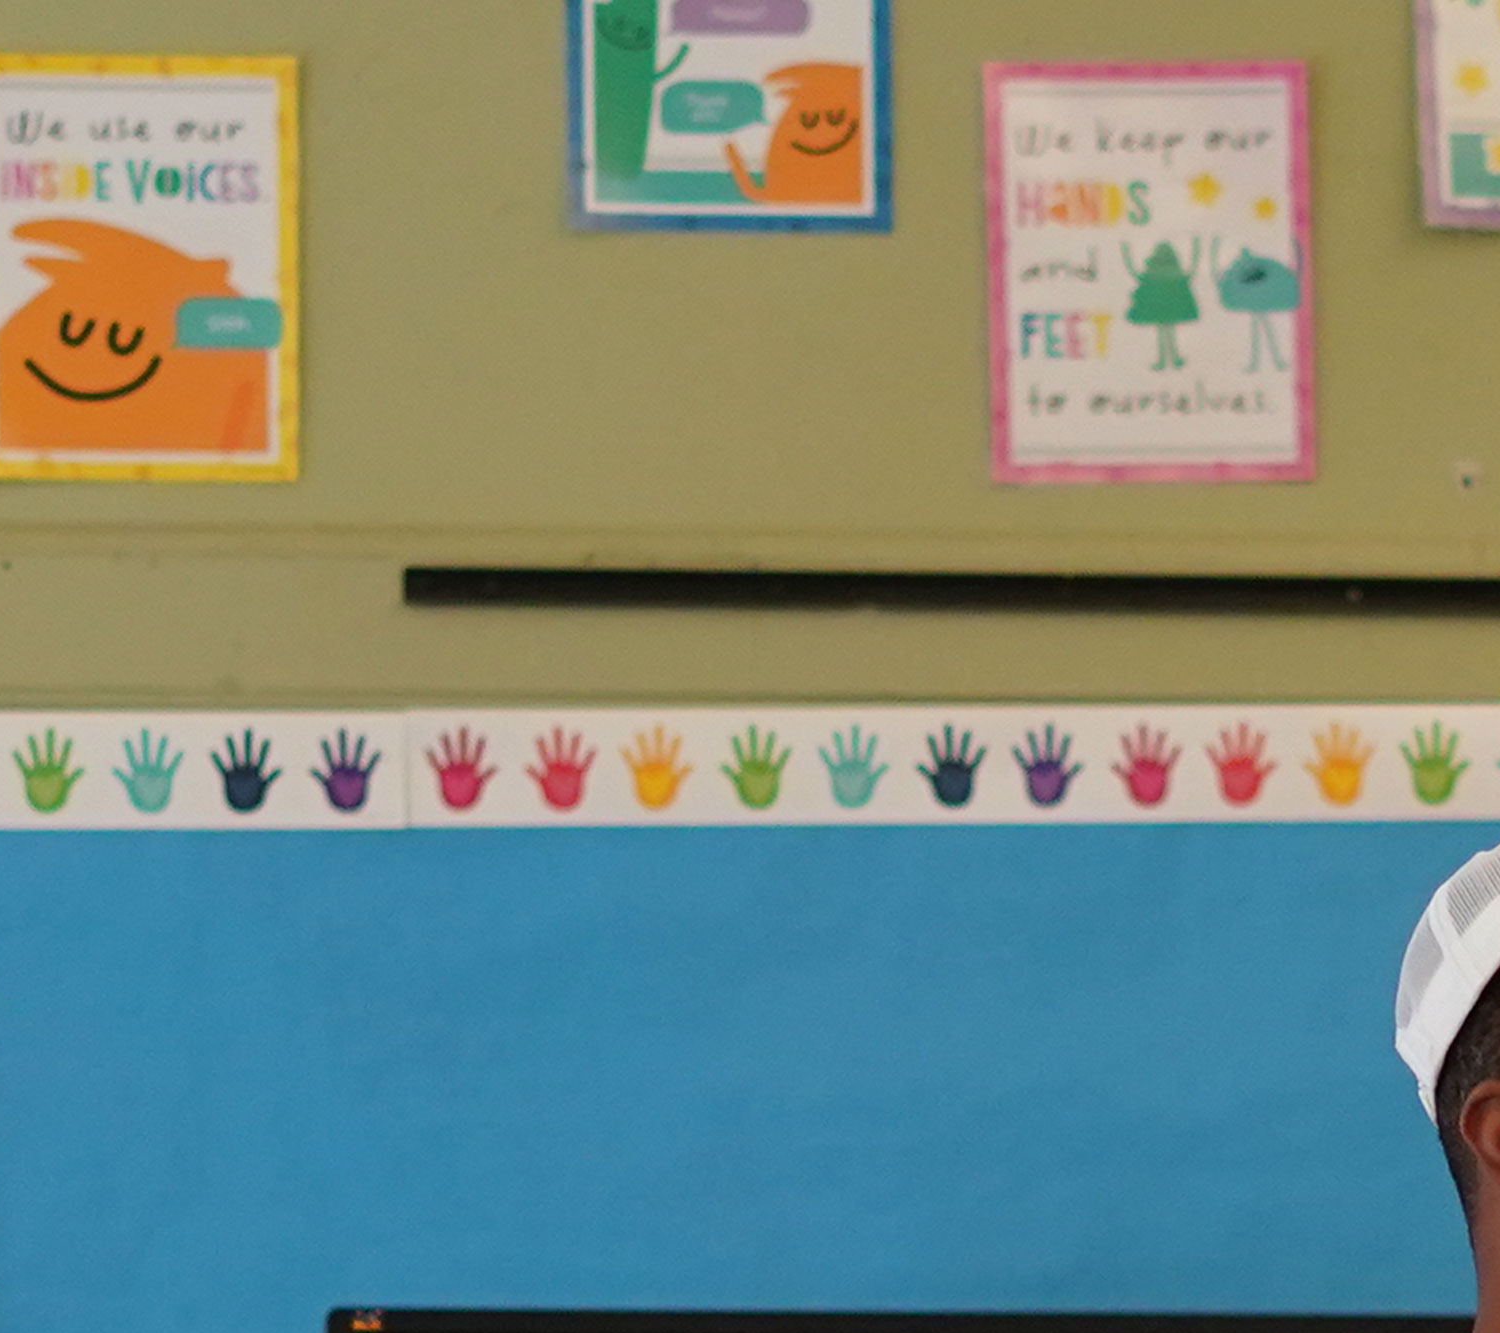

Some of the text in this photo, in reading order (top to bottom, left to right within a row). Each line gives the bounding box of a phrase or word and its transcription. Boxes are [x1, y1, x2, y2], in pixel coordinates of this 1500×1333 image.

[5, 111, 243, 145] We use our
[1014, 116, 1270, 166] We keep our
[0, 161, 112, 202] INSIDE
[1014, 179, 1152, 229] HANDS
[1020, 246, 1098, 283] and
[1019, 311, 1112, 359] FEET
[1026, 383, 1066, 416] to
